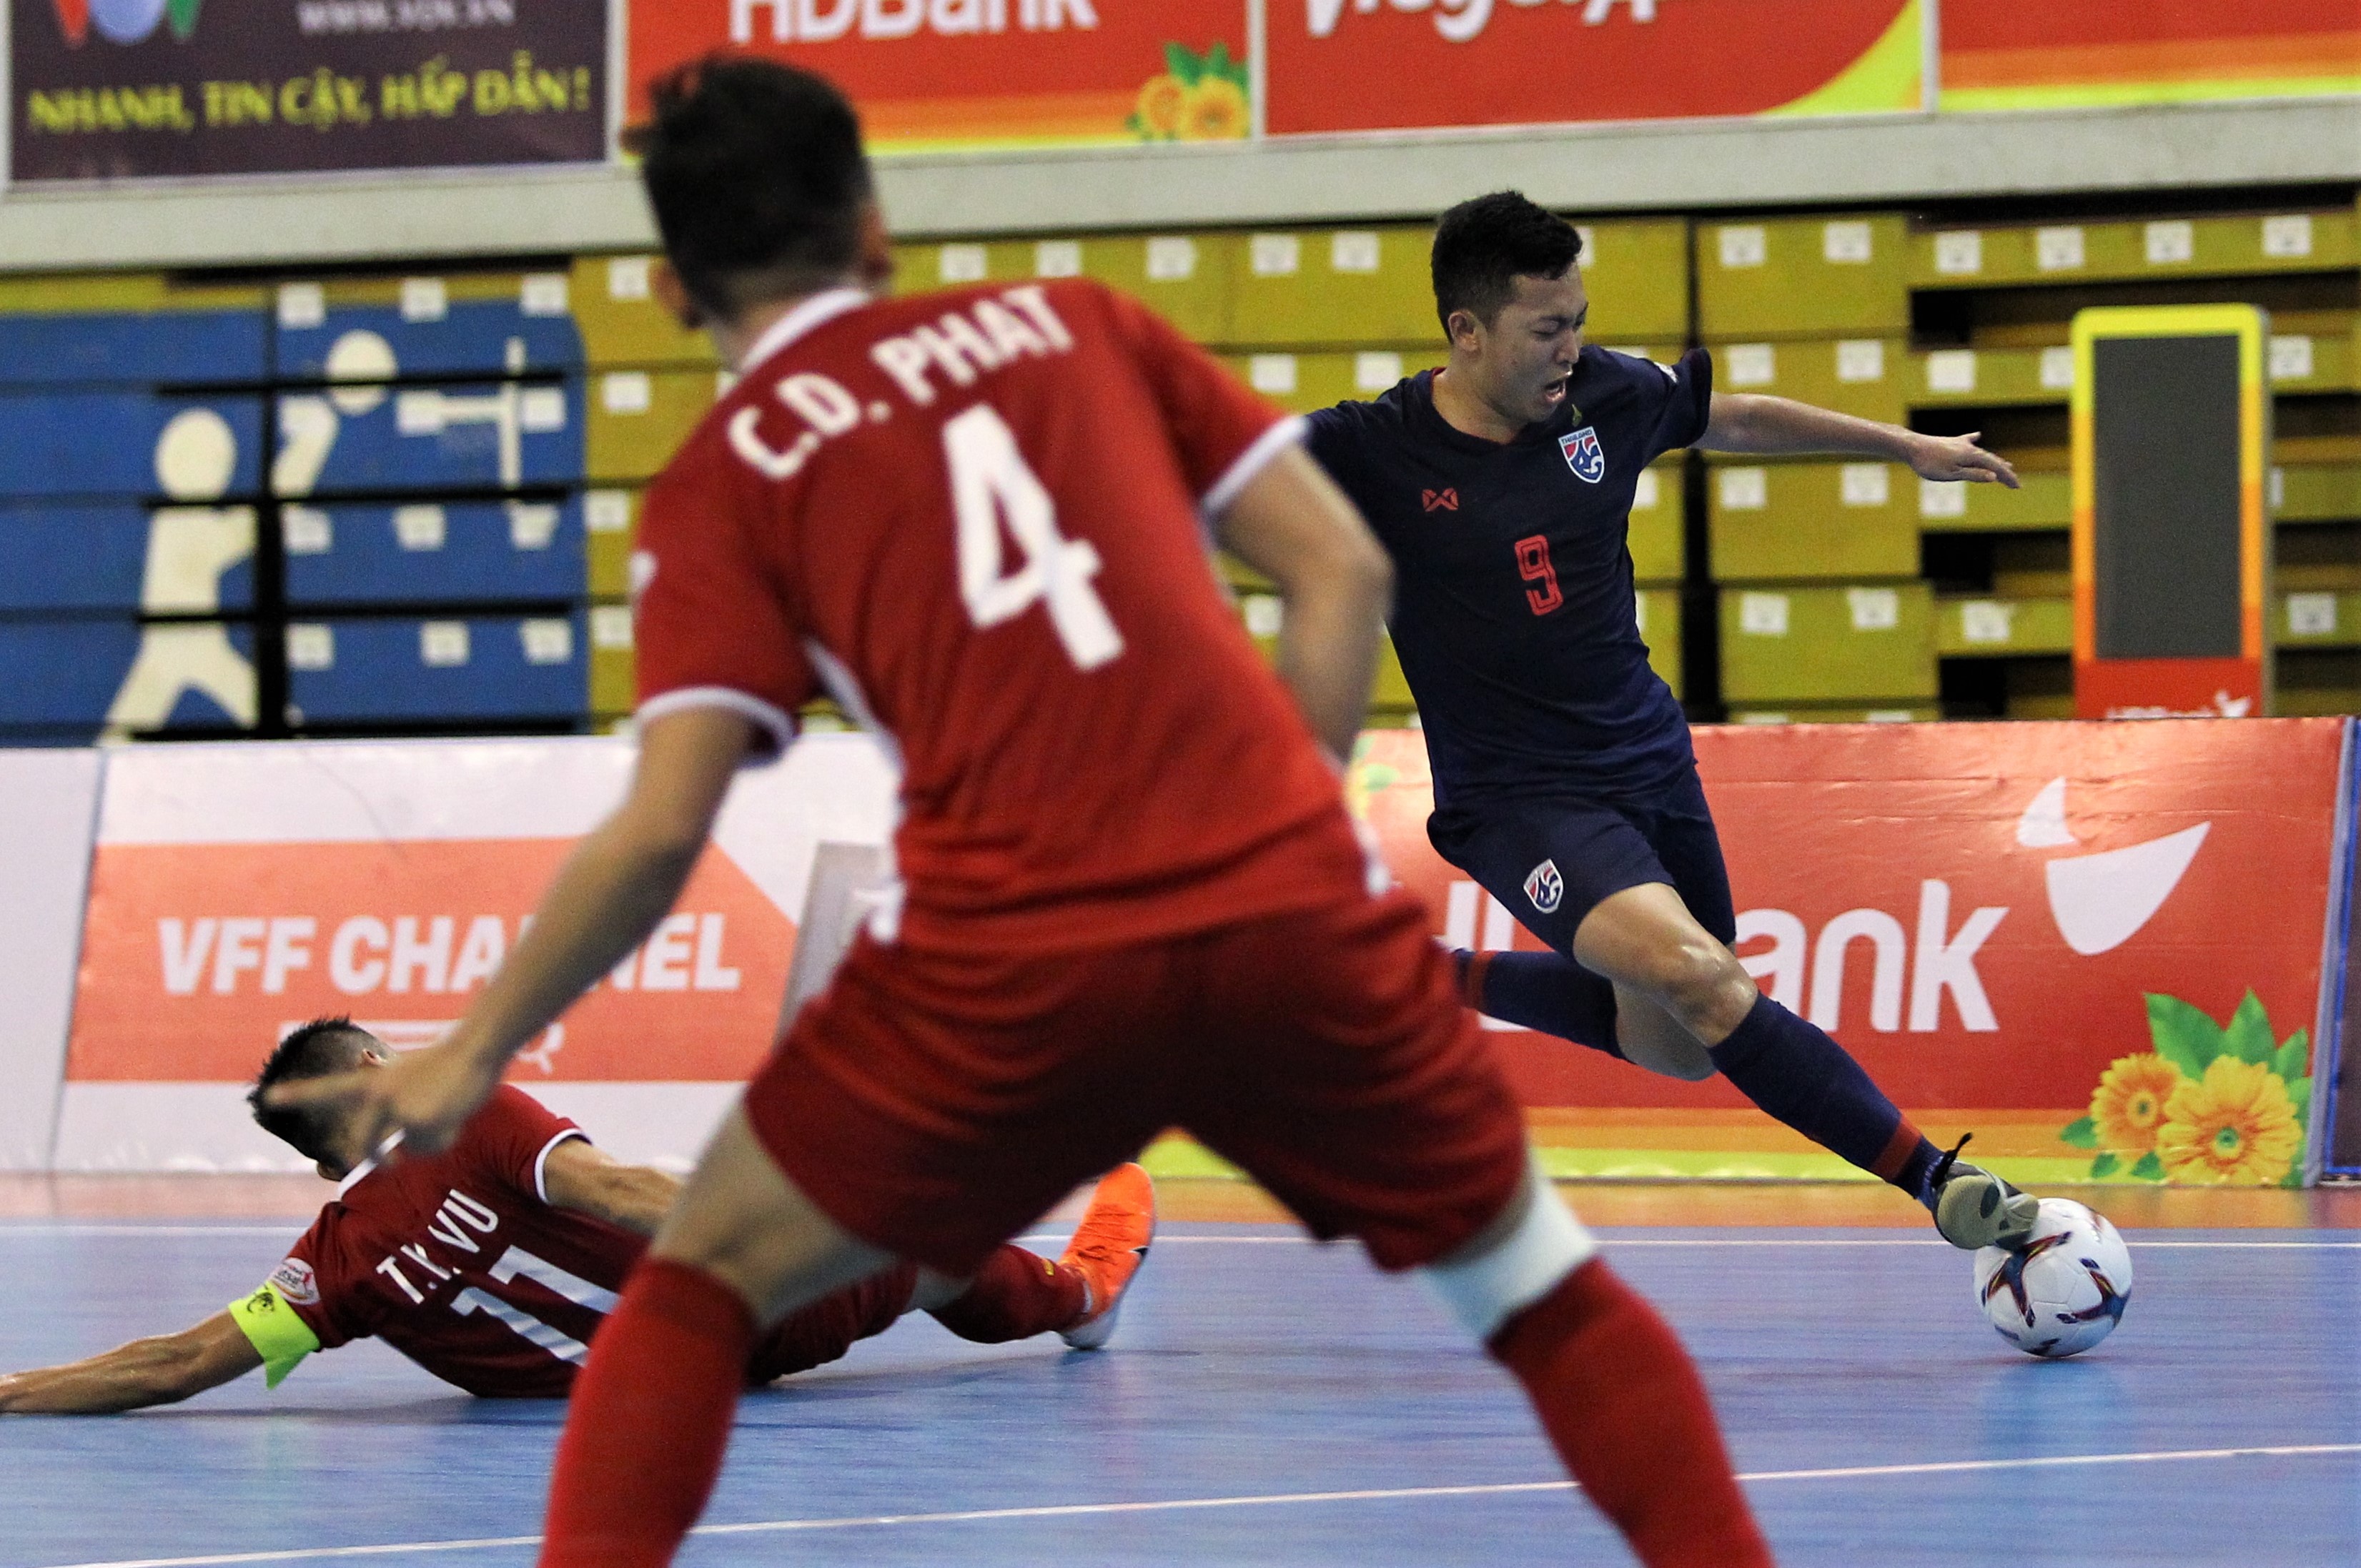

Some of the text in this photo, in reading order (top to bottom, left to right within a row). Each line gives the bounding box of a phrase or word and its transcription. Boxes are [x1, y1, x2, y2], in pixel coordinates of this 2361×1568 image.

[202, 79, 274, 128] TIN
[870, 285, 1074, 407] PHAT
[942, 402, 1124, 672] 4
[1514, 534, 1564, 616] 9
[157, 912, 741, 994] VFF CHAEL
[1432, 878, 2009, 1033] ank
[450, 1244, 622, 1367] 11
